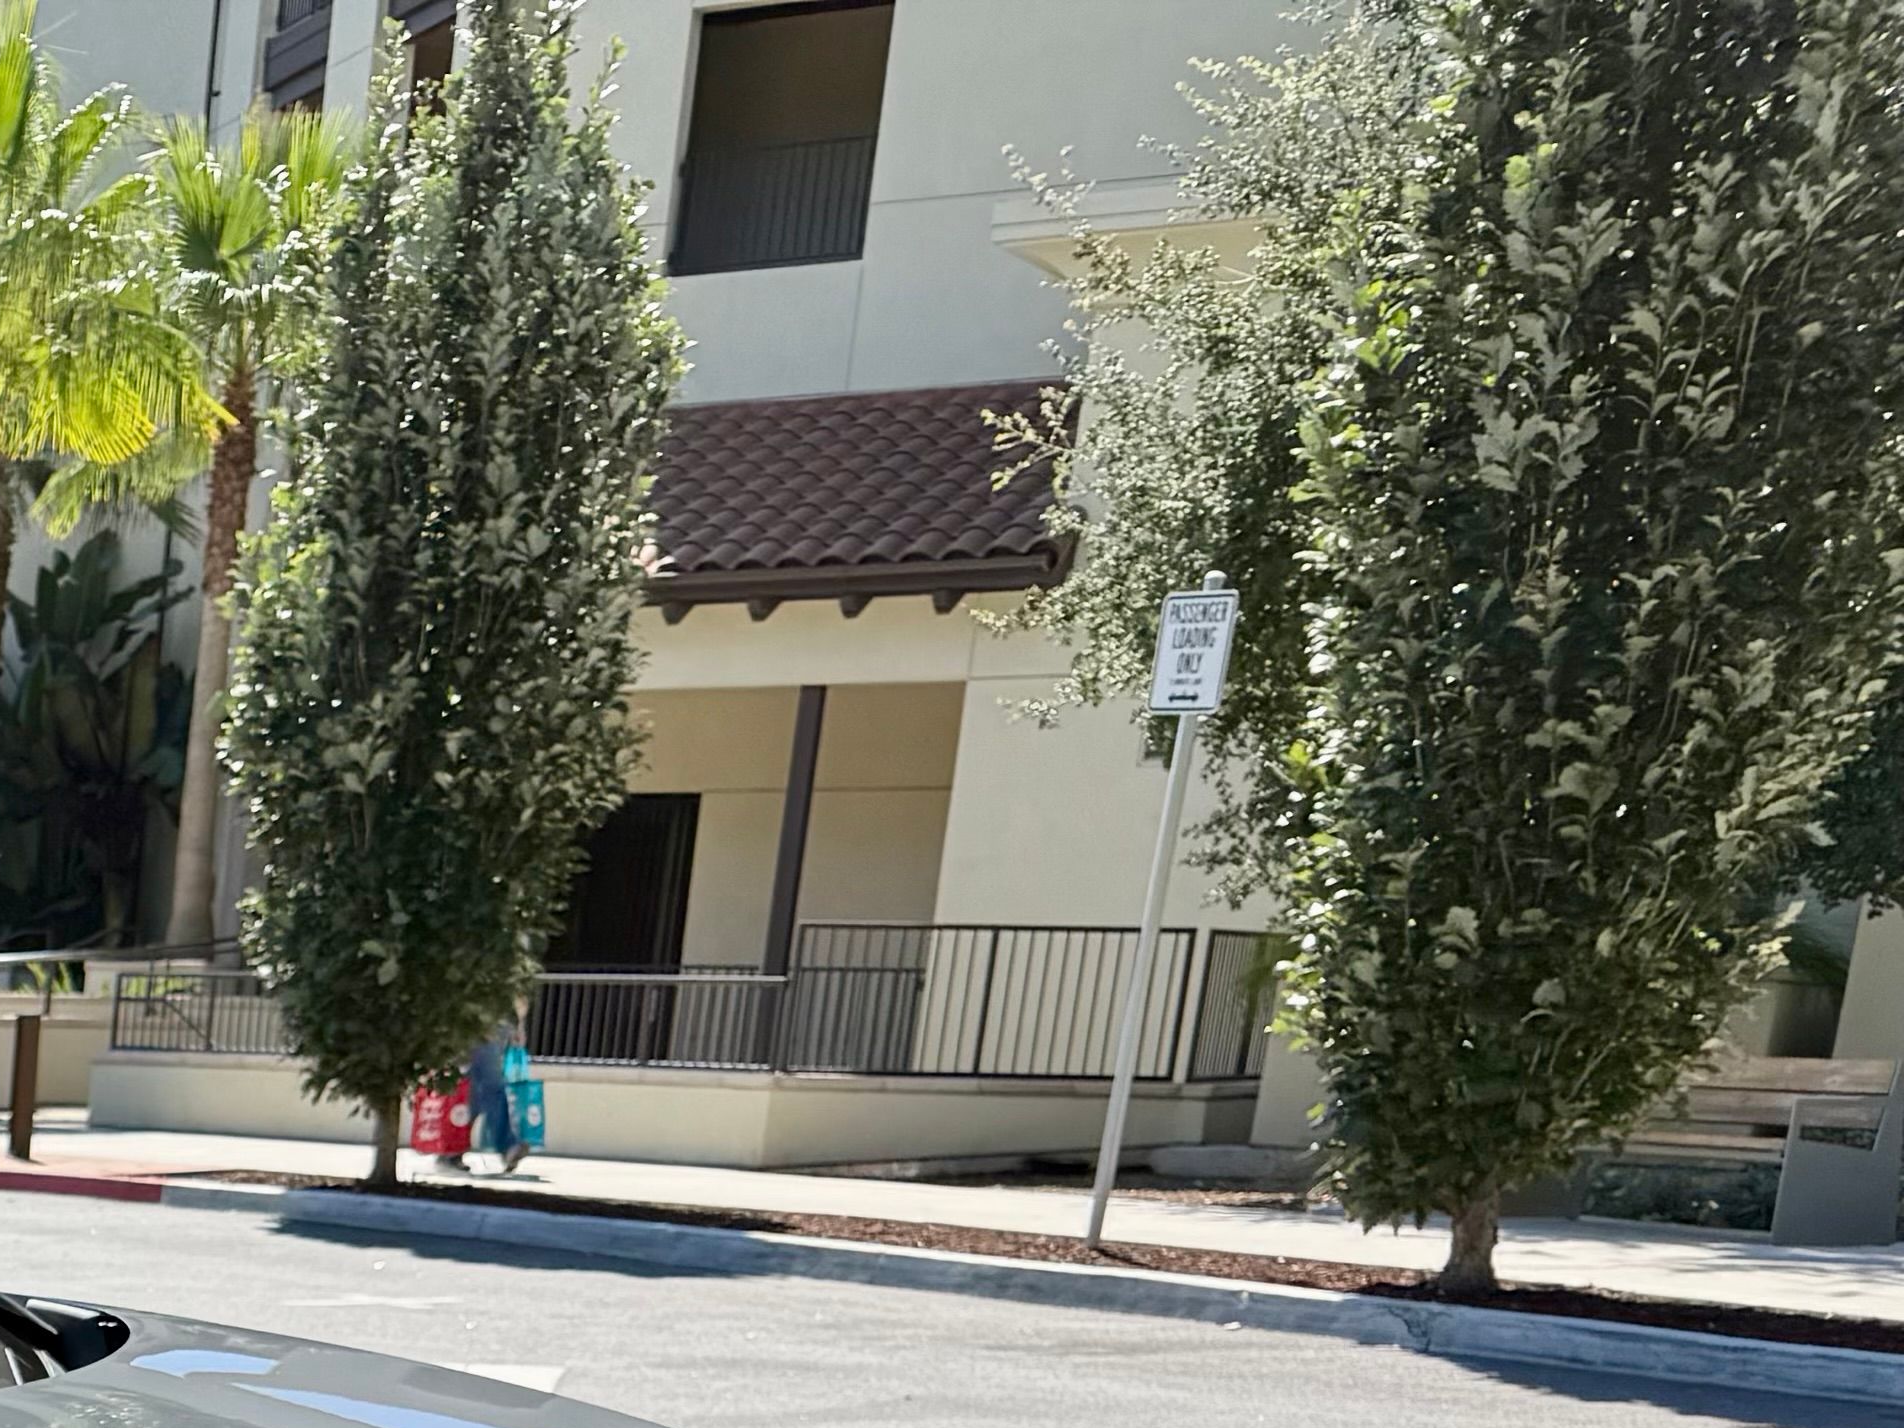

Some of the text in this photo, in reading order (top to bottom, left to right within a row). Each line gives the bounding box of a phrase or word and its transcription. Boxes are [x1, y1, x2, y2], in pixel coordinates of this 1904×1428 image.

[1169, 601, 1228, 624] PASSENGER
[1172, 627, 1218, 649] LOADING
[1176, 652, 1203, 675] ONLY
